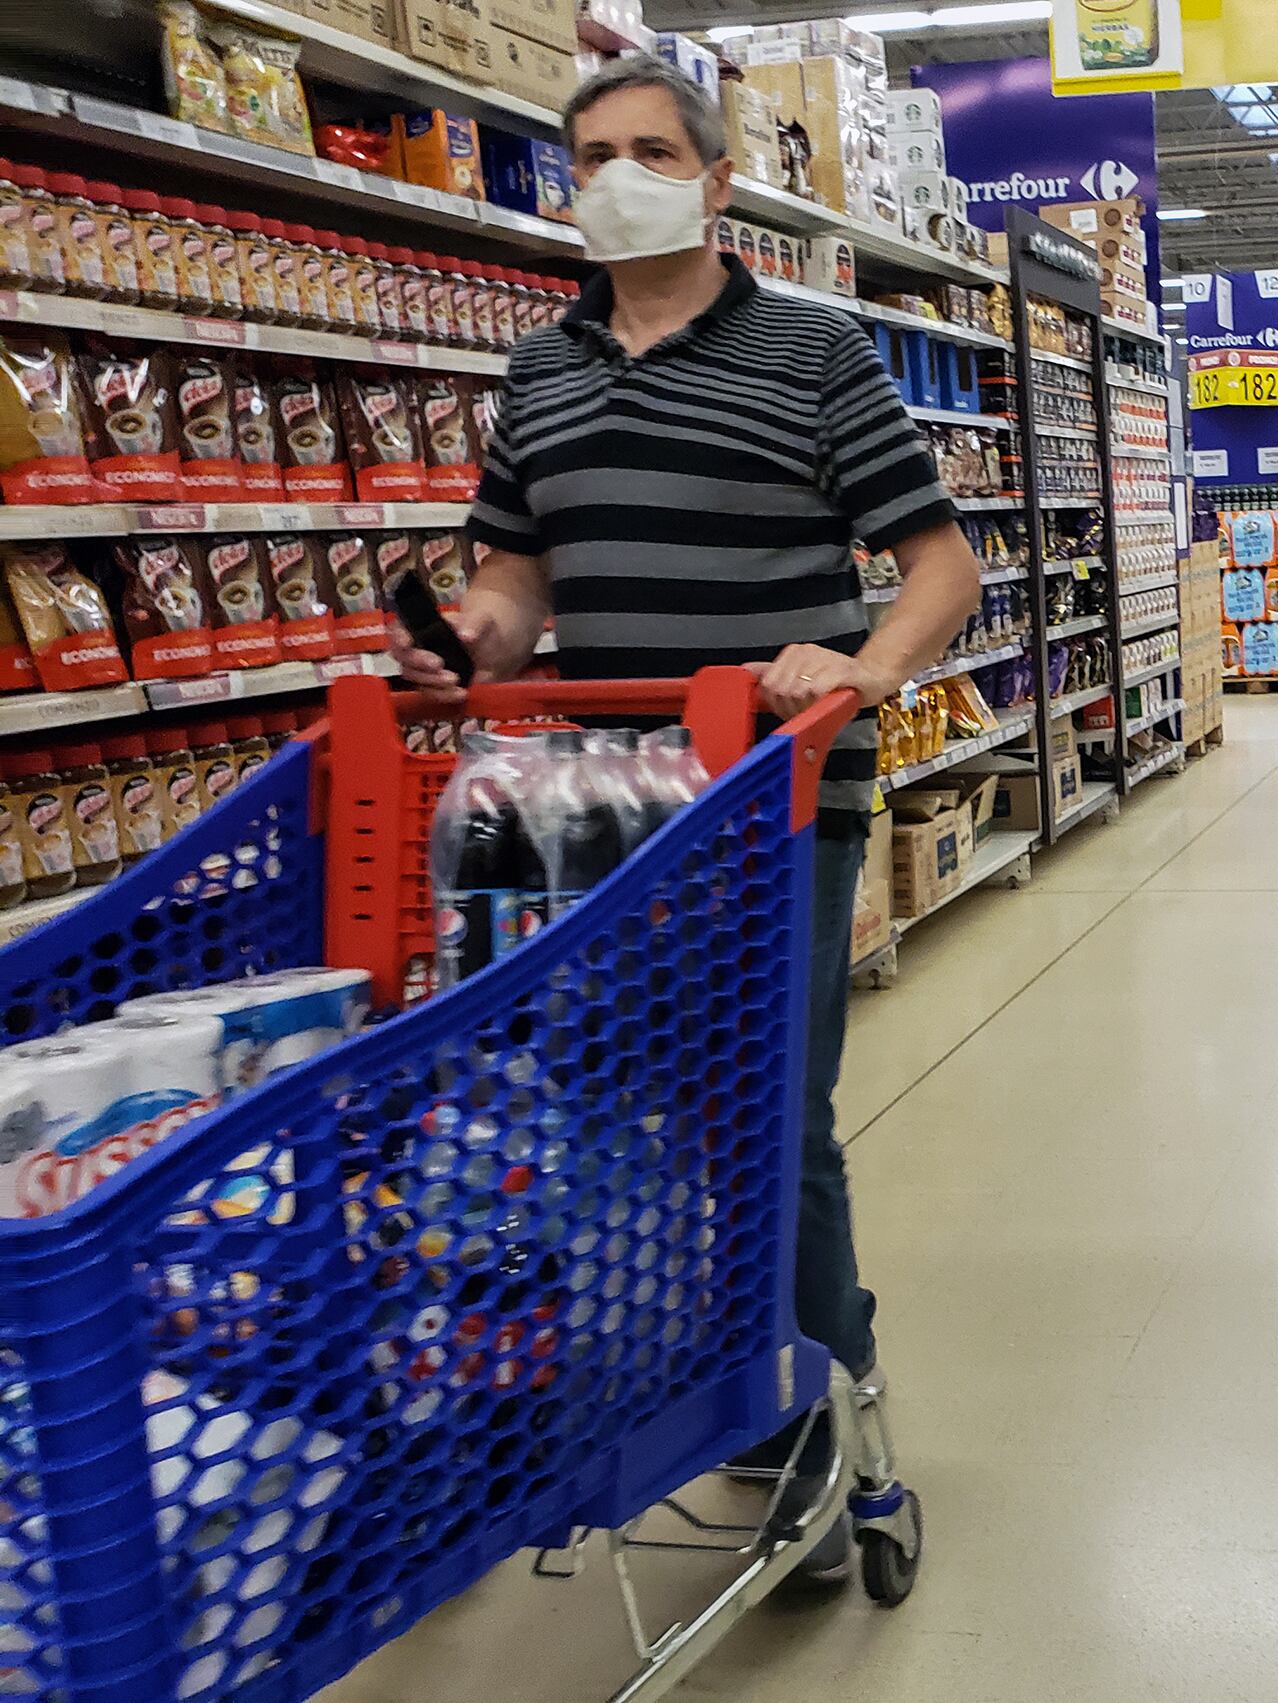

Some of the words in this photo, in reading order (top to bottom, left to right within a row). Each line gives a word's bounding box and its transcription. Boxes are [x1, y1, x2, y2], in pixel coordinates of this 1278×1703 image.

[957, 172, 1070, 202] rrefour
[1189, 282, 1206, 296] 10
[1190, 332, 1254, 348] Carrefour
[1196, 373, 1219, 404] 182
[1240, 372, 1277, 401] 182
